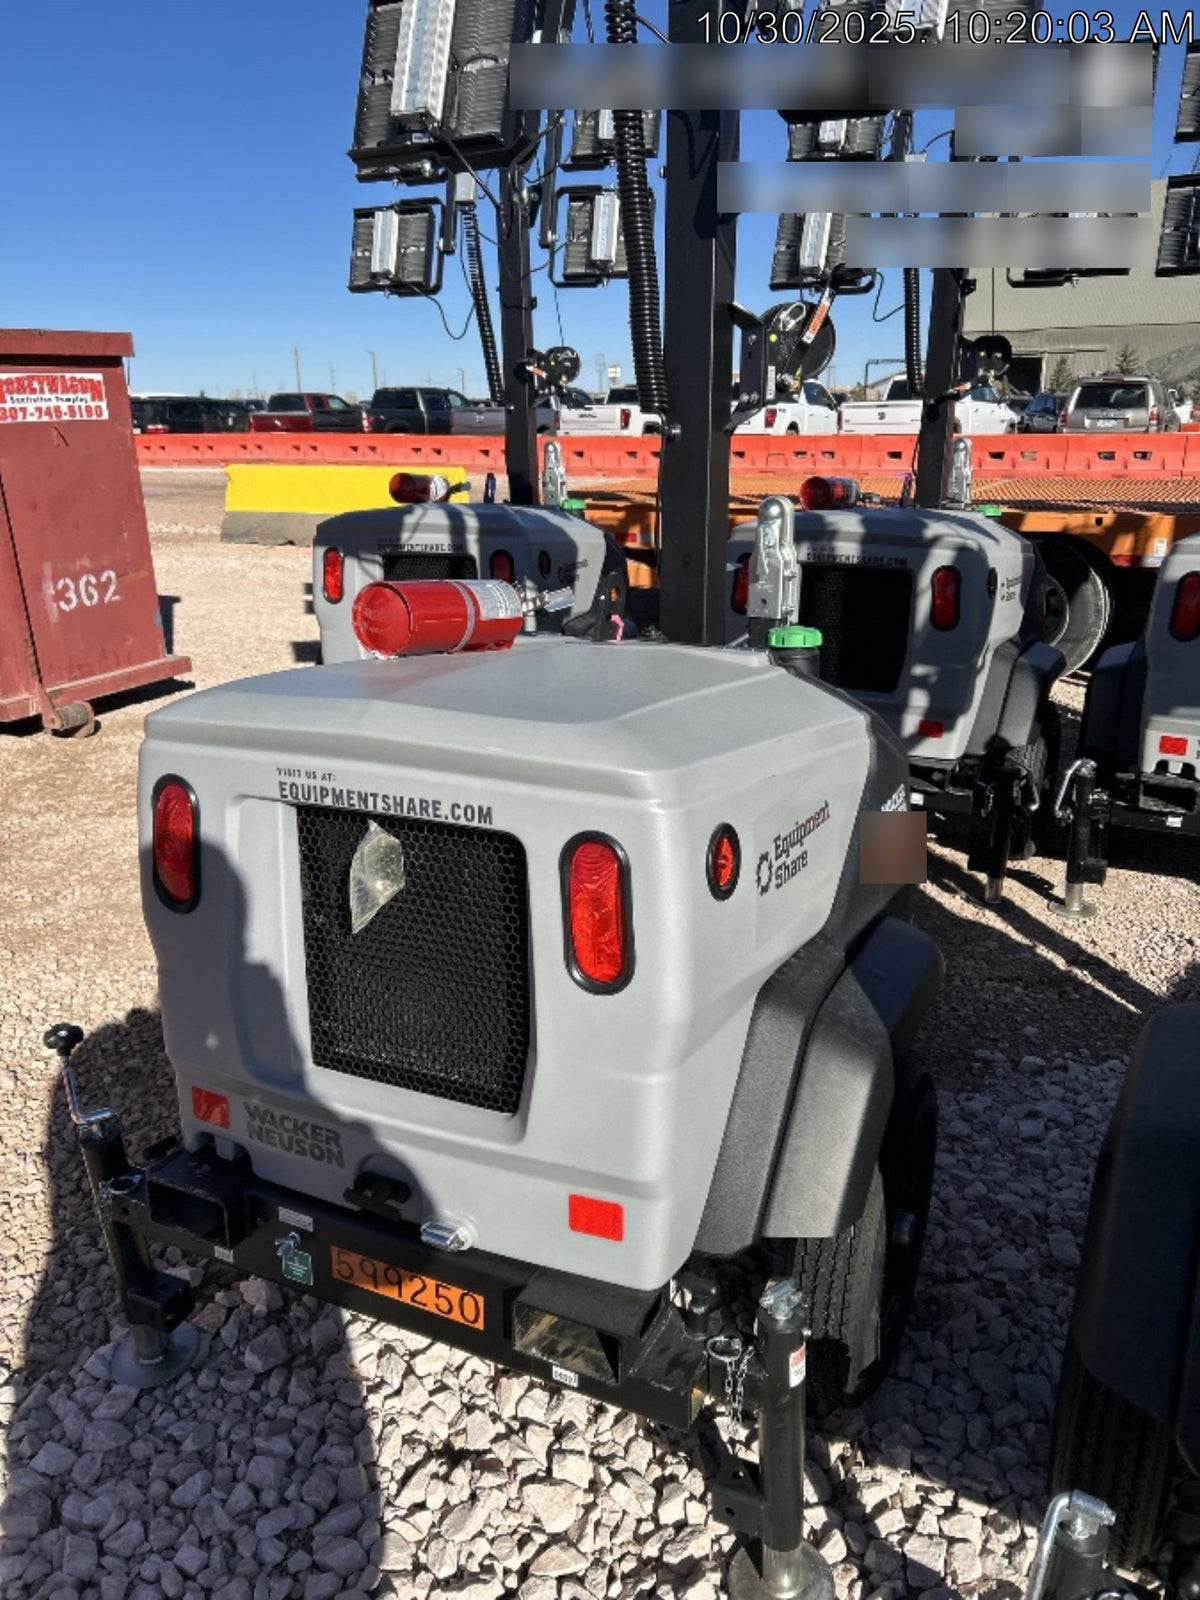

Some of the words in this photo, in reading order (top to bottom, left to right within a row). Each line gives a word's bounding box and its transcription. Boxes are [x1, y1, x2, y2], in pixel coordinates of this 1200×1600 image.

[57, 569, 120, 612] 362
[277, 767, 301, 778] VISIT
[305, 770, 317, 780] US
[321, 772, 337, 782] AT:
[279, 780, 494, 826] EQUIPMENTSHARE.COM
[773, 800, 831, 861] Equipment
[774, 850, 809, 890] Share
[243, 1101, 343, 1149] WACKER
[246, 1121, 346, 1169] NEUSON
[336, 1250, 481, 1325] 599250
